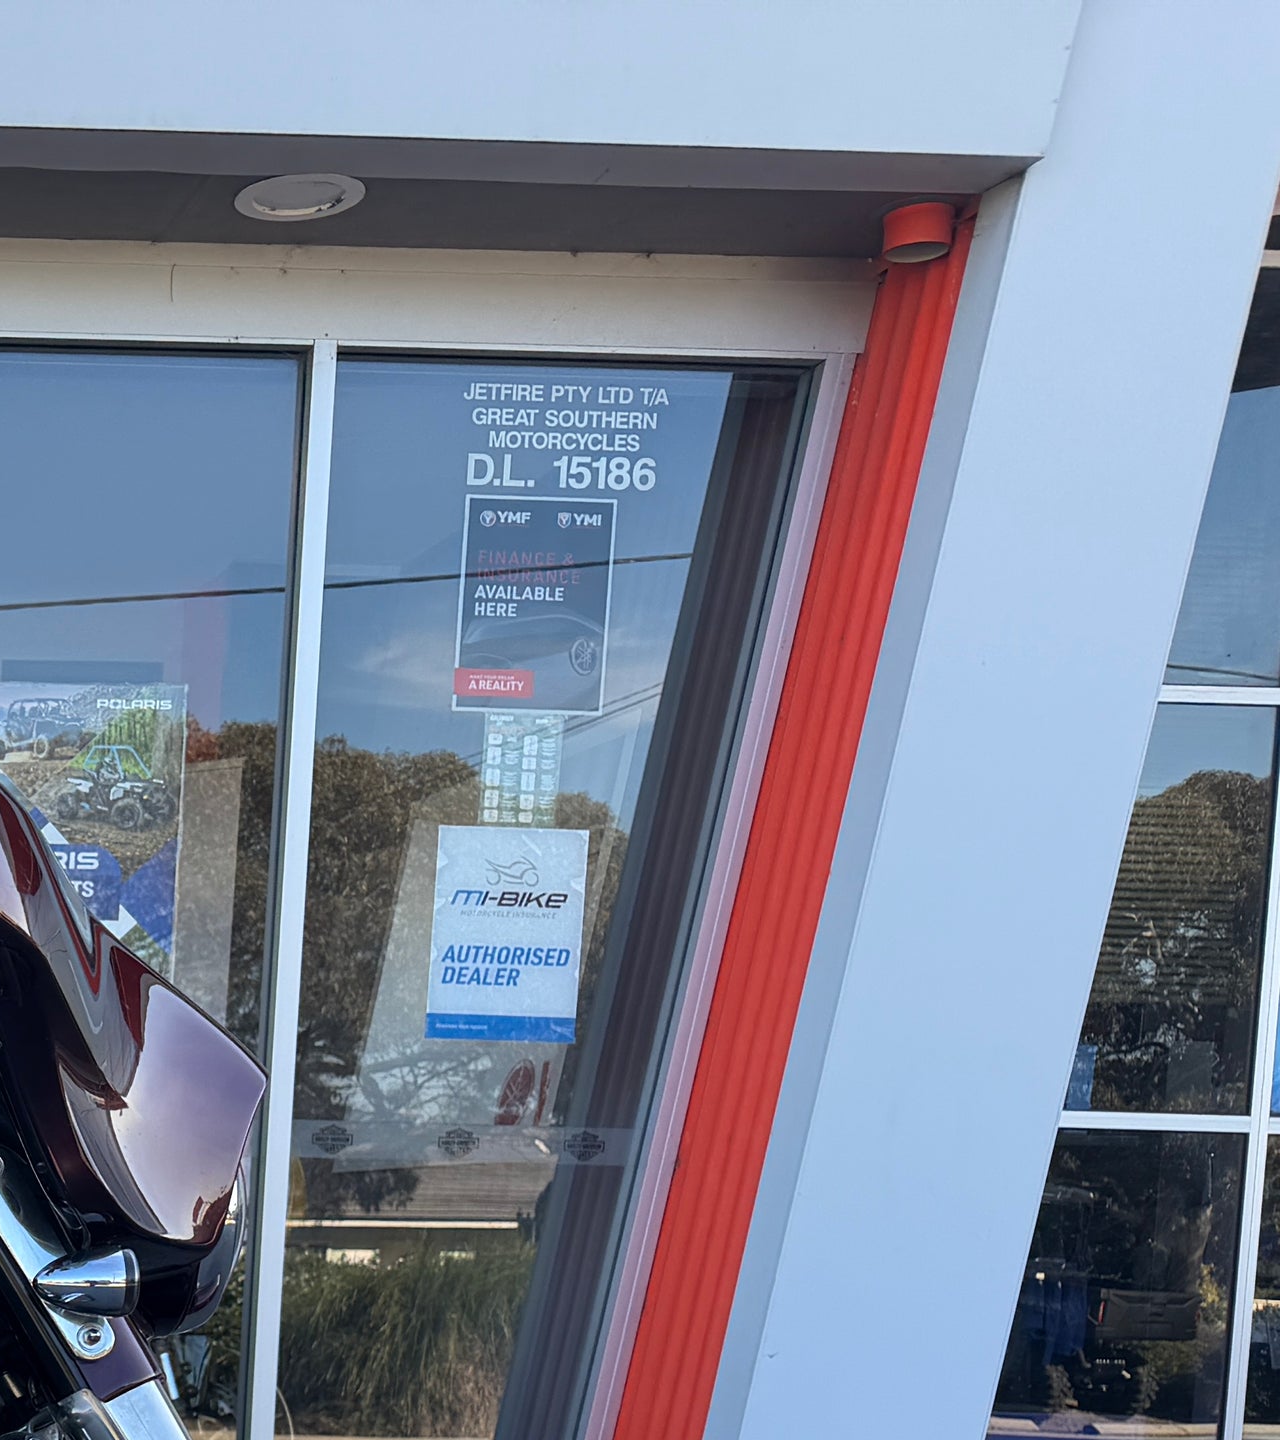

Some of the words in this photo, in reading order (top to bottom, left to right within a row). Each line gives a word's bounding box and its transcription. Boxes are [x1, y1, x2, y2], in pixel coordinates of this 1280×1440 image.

[464, 383, 544, 401] JETFIRE
[551, 385, 592, 403] PTY
[598, 387, 633, 405] LTD
[640, 388, 669, 406] T/A
[472, 408, 539, 426] GREAT
[545, 410, 657, 429] SOUTHERN
[489, 431, 640, 452] MOTORCYCLES
[466, 453, 535, 487] D.L.
[553, 455, 657, 491] 15186
[497, 511, 531, 524] YMF
[574, 514, 602, 526] YMI
[478, 550, 556, 566] FINANCE
[561, 552, 574, 565] &
[474, 585, 564, 601] AVAILABLE
[474, 603, 517, 617] HERE
[468, 679, 477, 691] A
[479, 680, 525, 693] REALITY
[96, 699, 172, 711] POLARIS
[441, 945, 570, 967] AUTHORISED
[441, 967, 520, 987] DEALER
